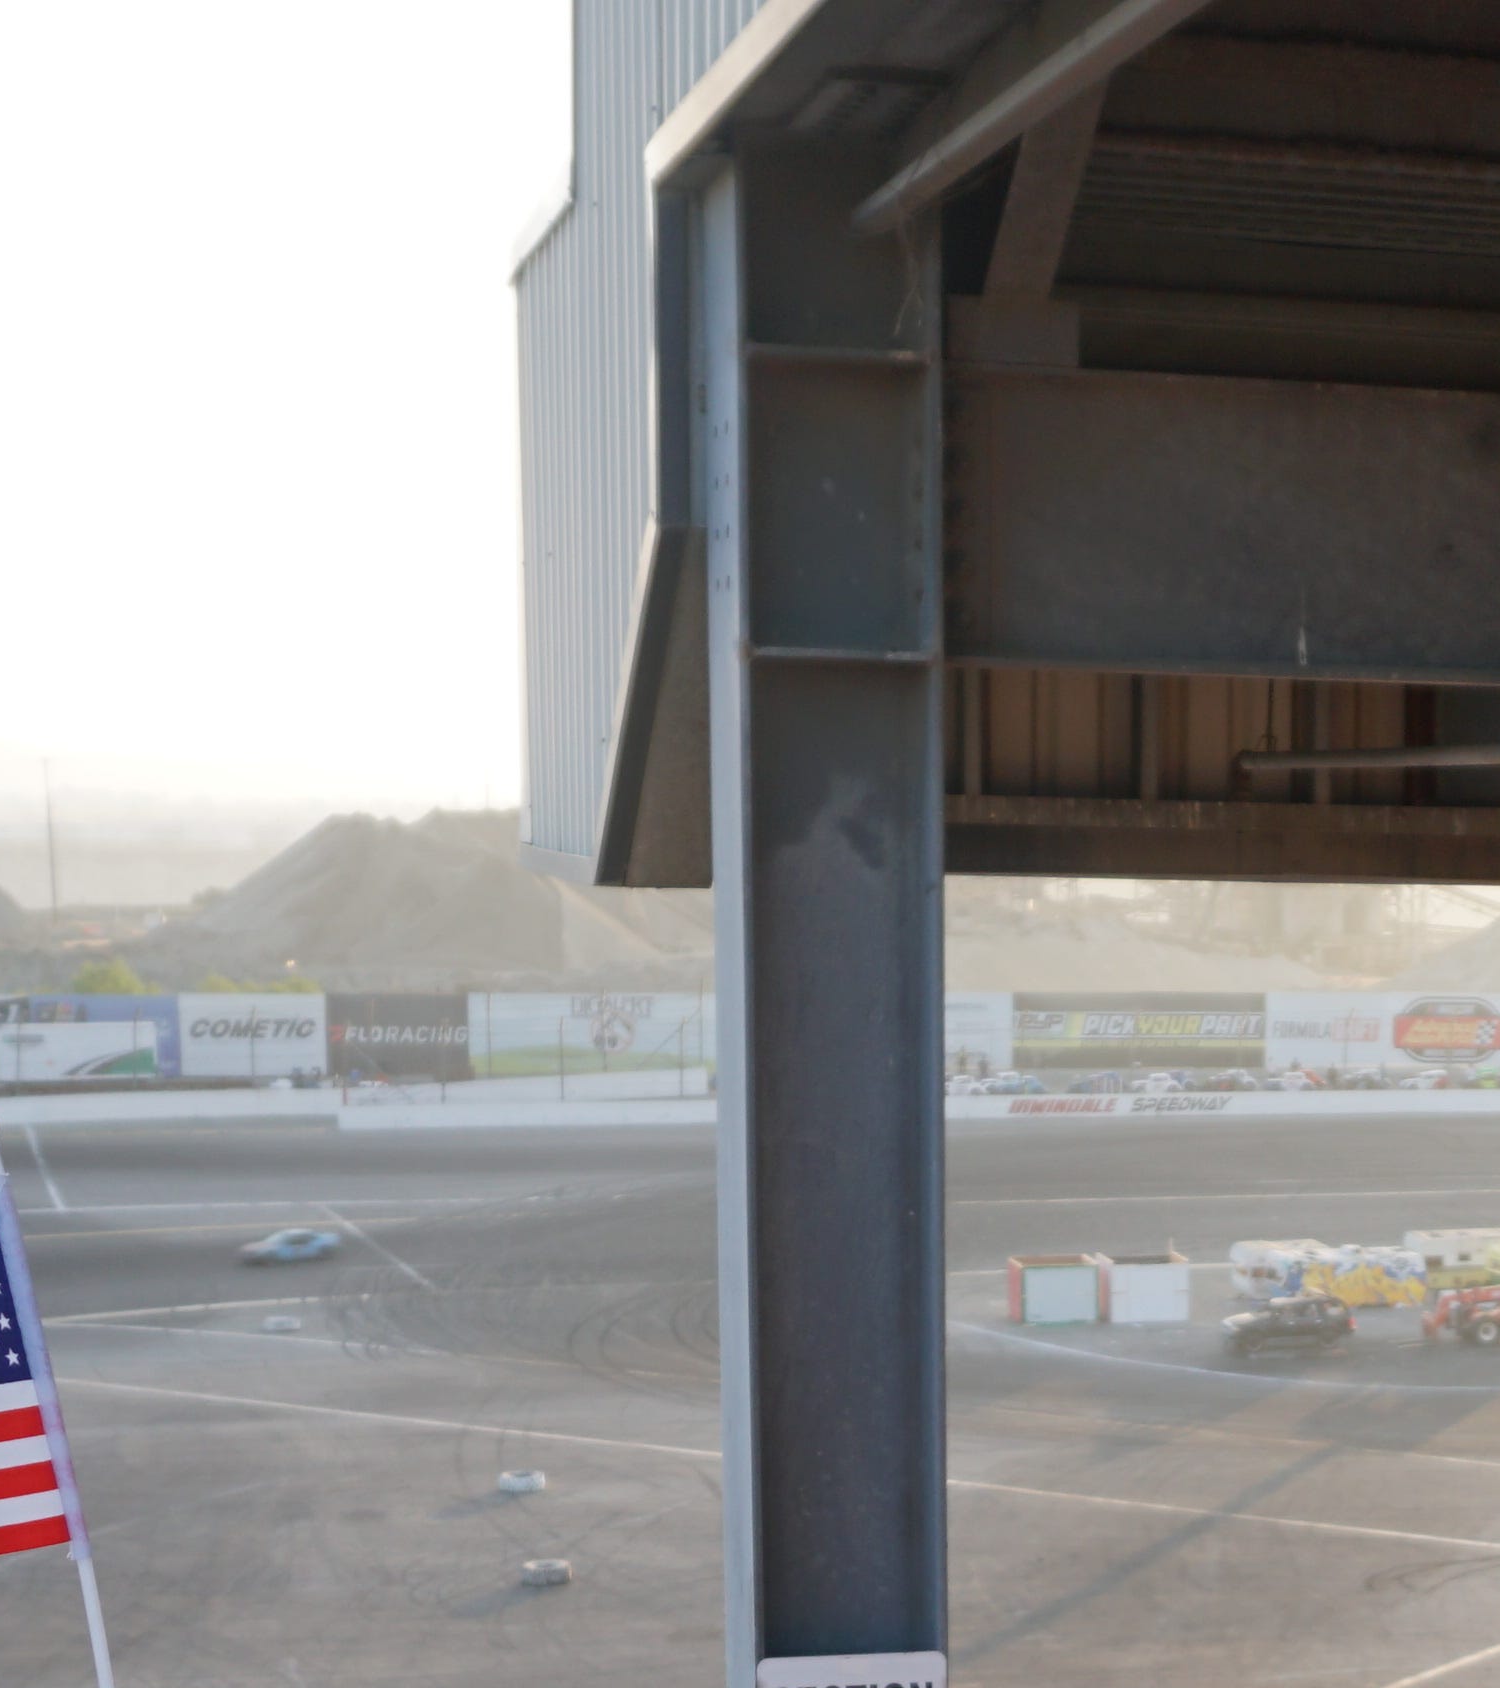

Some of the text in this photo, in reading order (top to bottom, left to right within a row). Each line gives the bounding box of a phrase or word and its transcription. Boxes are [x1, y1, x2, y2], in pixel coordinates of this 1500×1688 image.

[190, 1017, 317, 1040] COMETIC
[1008, 1094, 1233, 1114] IRWINDALE SPEEDWAY
